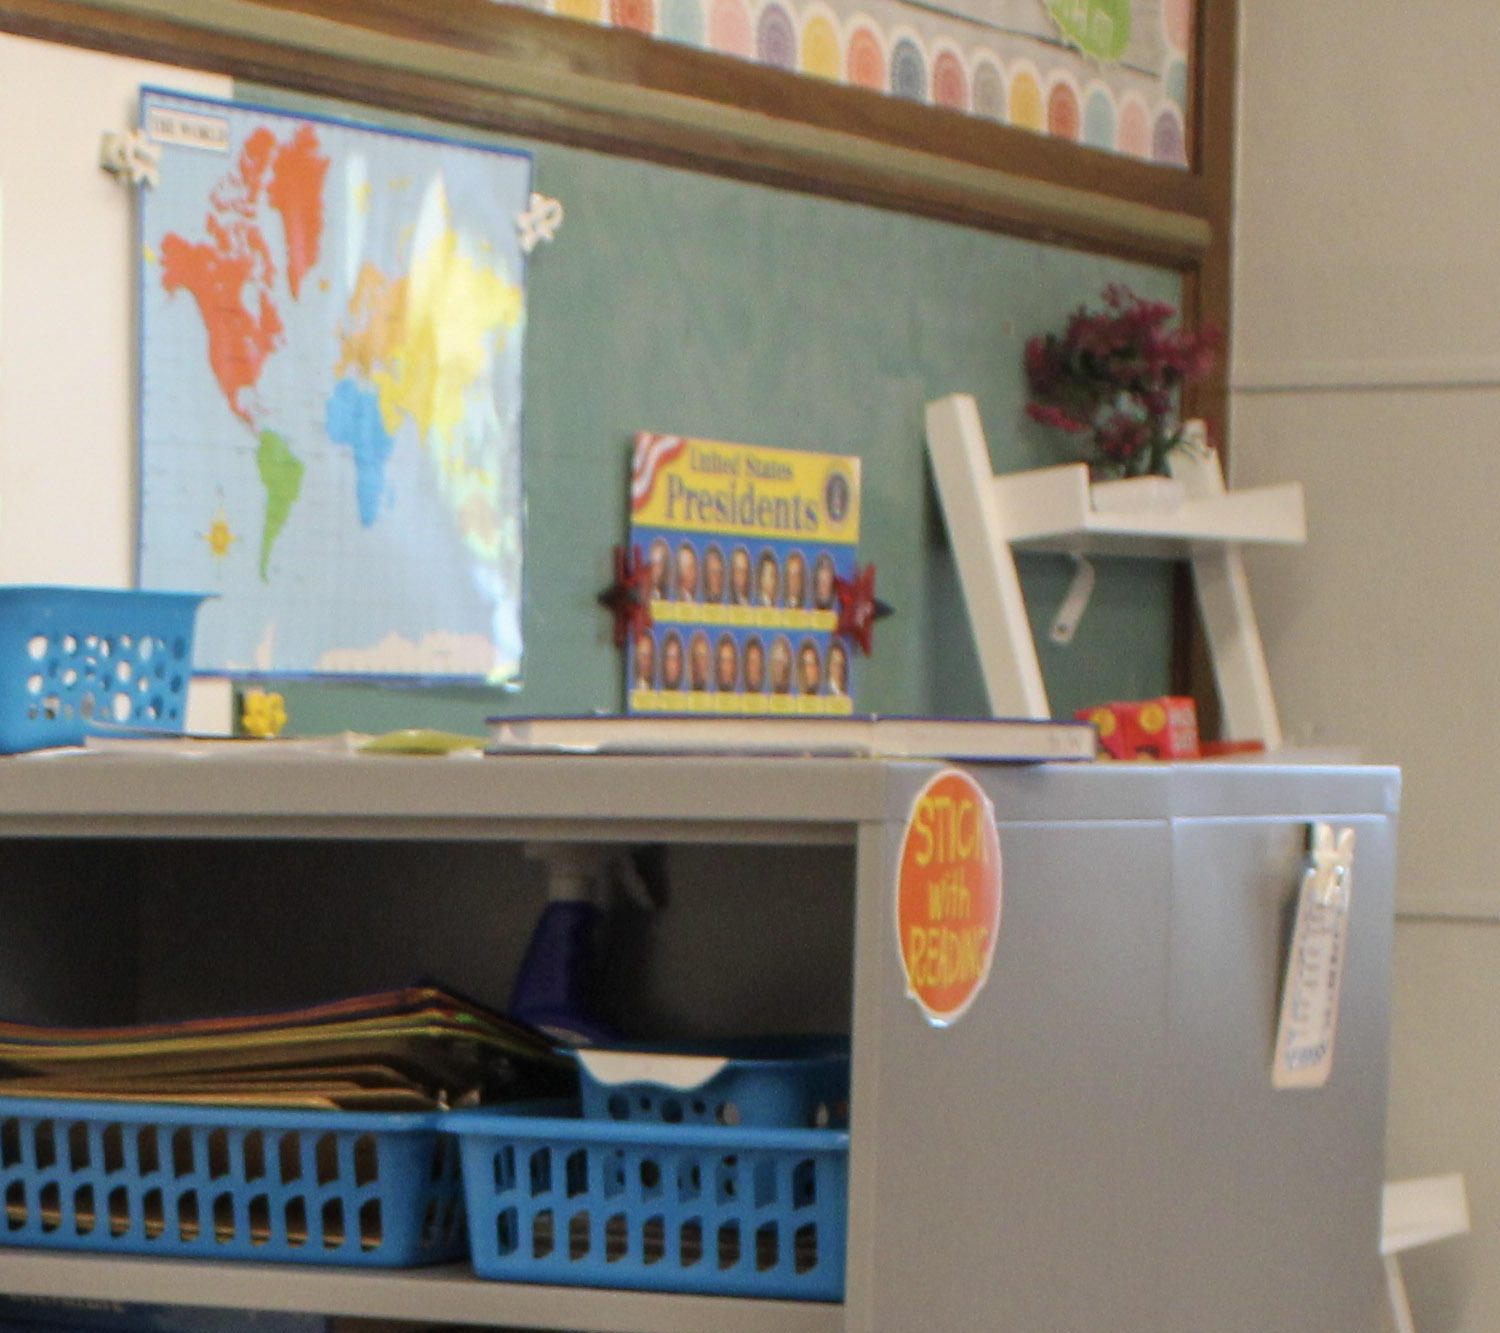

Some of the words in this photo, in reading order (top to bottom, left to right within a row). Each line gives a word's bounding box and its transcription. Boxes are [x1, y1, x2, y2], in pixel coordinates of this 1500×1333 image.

[690, 447, 739, 477] United
[745, 457, 795, 483] States
[664, 472, 820, 532] Presidents
[915, 796, 990, 867] STICK
[928, 866, 972, 922] with
[909, 925, 990, 989] READING
